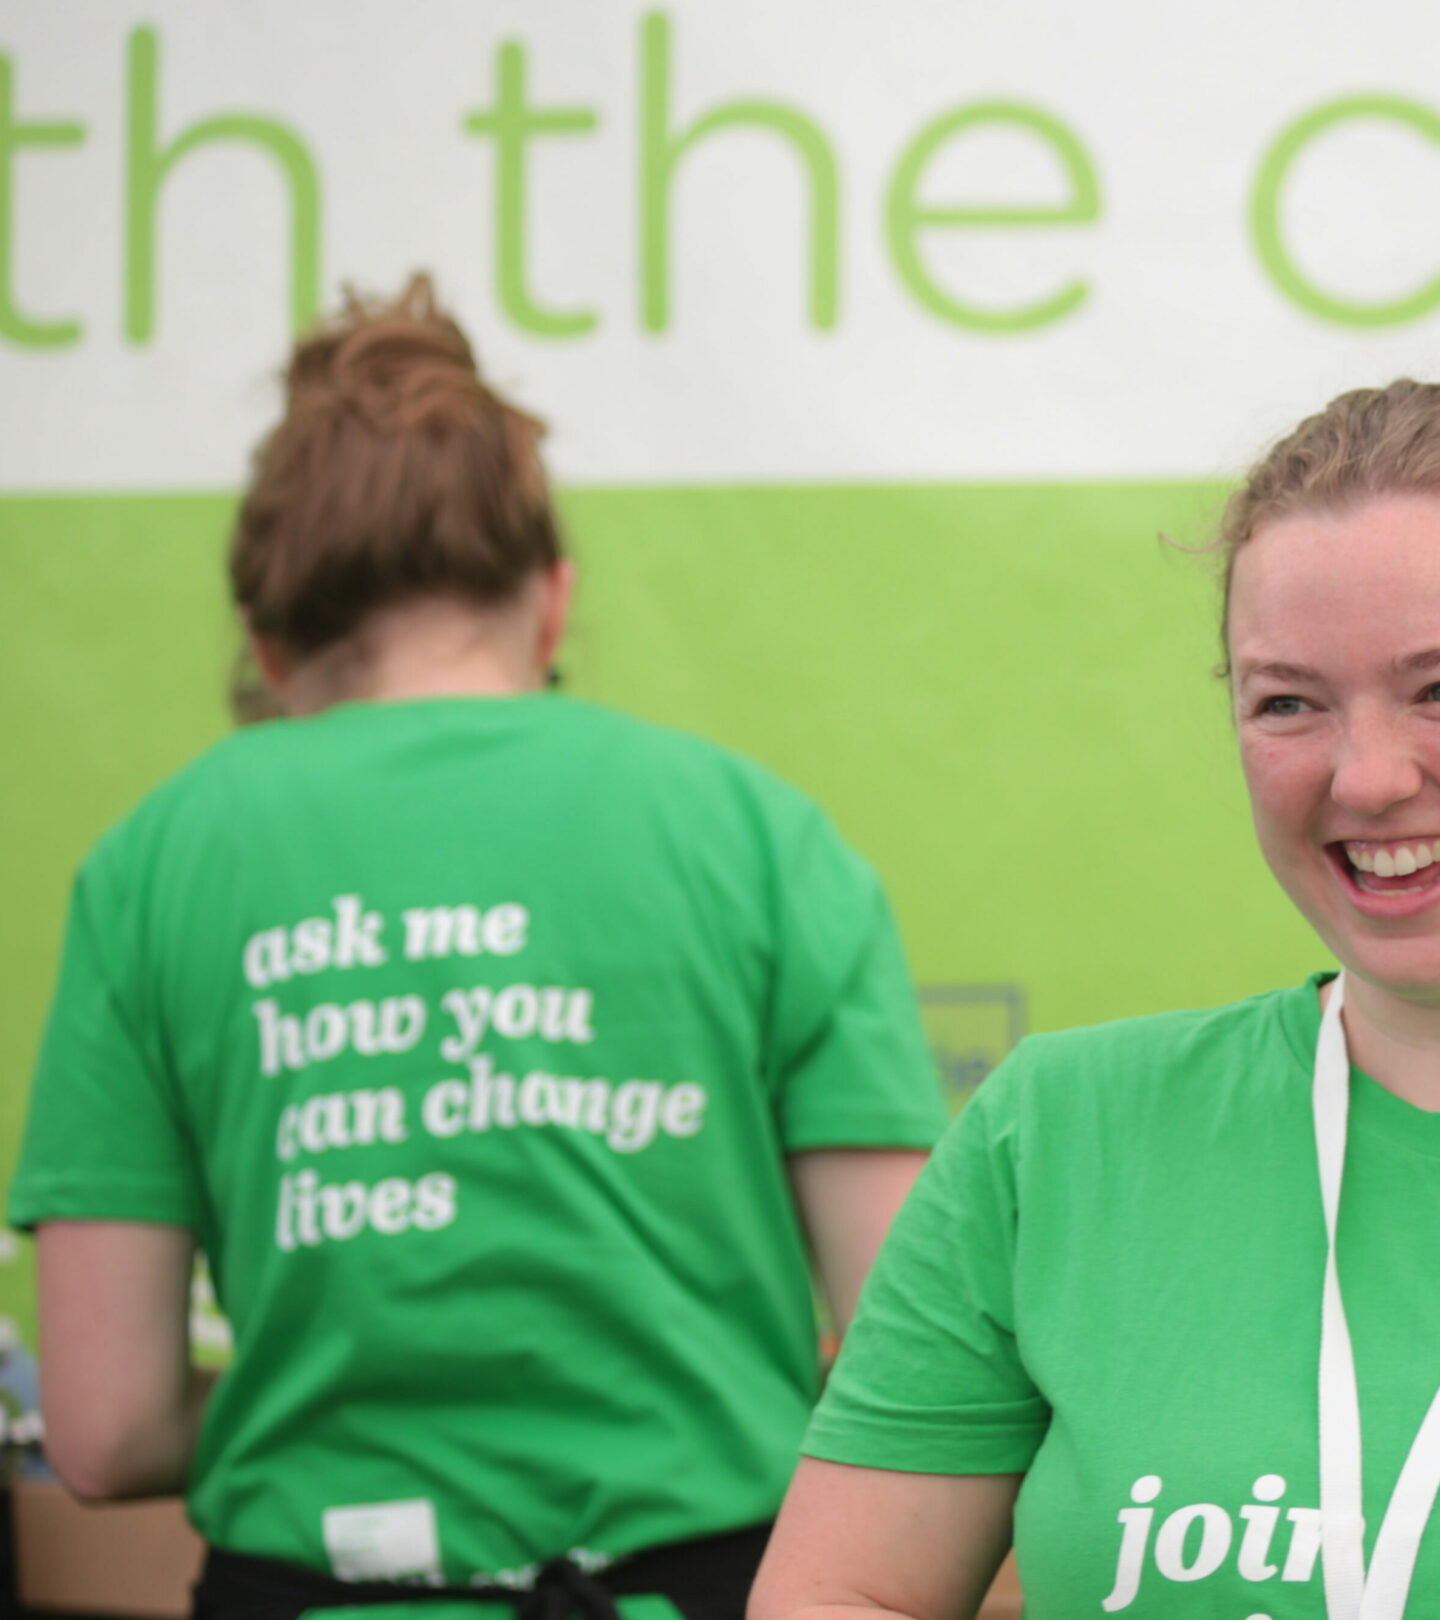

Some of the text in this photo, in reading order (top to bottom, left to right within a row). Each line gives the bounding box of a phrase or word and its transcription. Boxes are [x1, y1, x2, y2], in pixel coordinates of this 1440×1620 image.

[462, 8, 1104, 341] the
[244, 894, 529, 988] ask me
[254, 983, 594, 1076] how you
[275, 1053, 707, 1163] can change
[275, 1169, 458, 1252] lives
